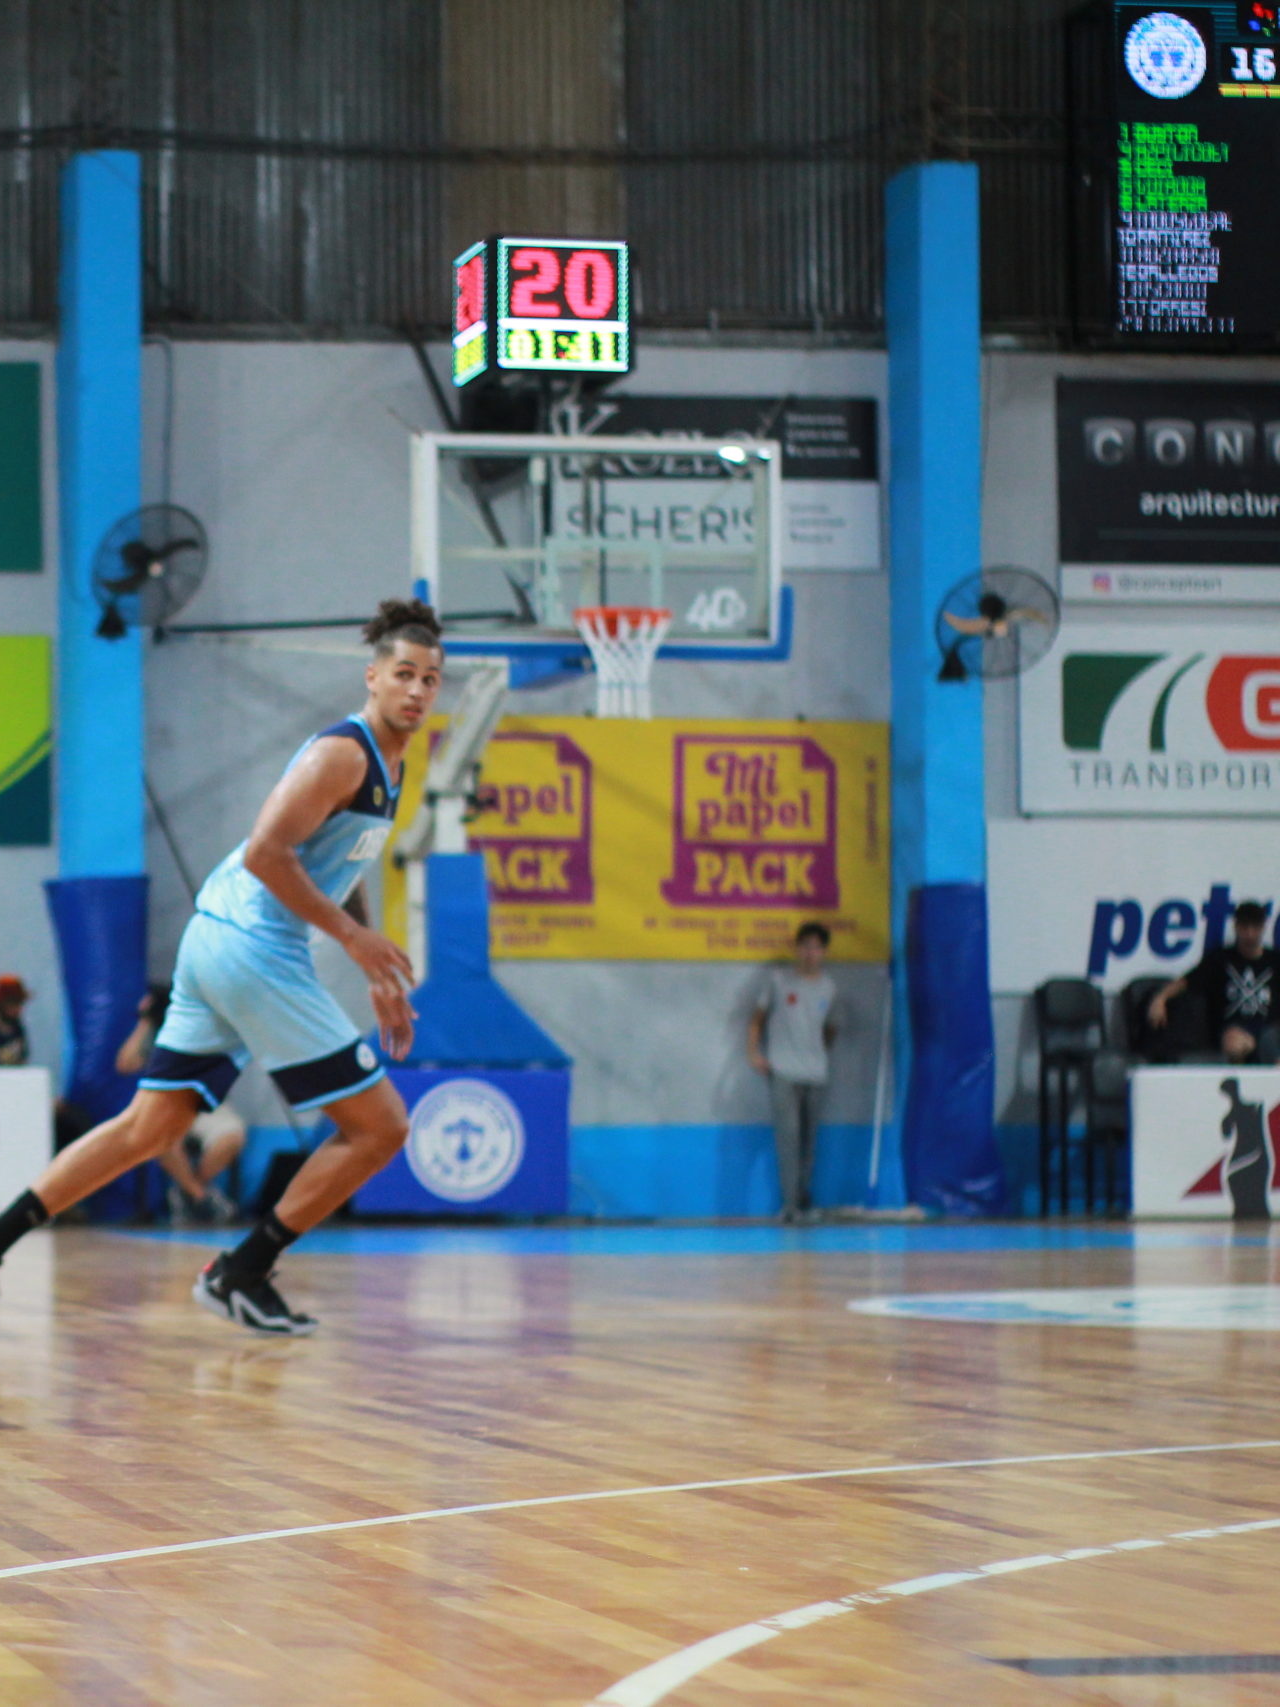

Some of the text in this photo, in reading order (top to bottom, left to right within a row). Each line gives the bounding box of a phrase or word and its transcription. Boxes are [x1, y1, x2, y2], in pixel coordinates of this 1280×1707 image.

[1231, 47, 1276, 81] 16
[510, 247, 615, 319] 20
[1093, 427, 1280, 465] CON
[1070, 760, 1280, 789] TRANSPOR
[474, 773, 575, 826] apel
[698, 790, 812, 842] papel
[485, 849, 569, 893] ACK
[693, 852, 816, 896] PACK
